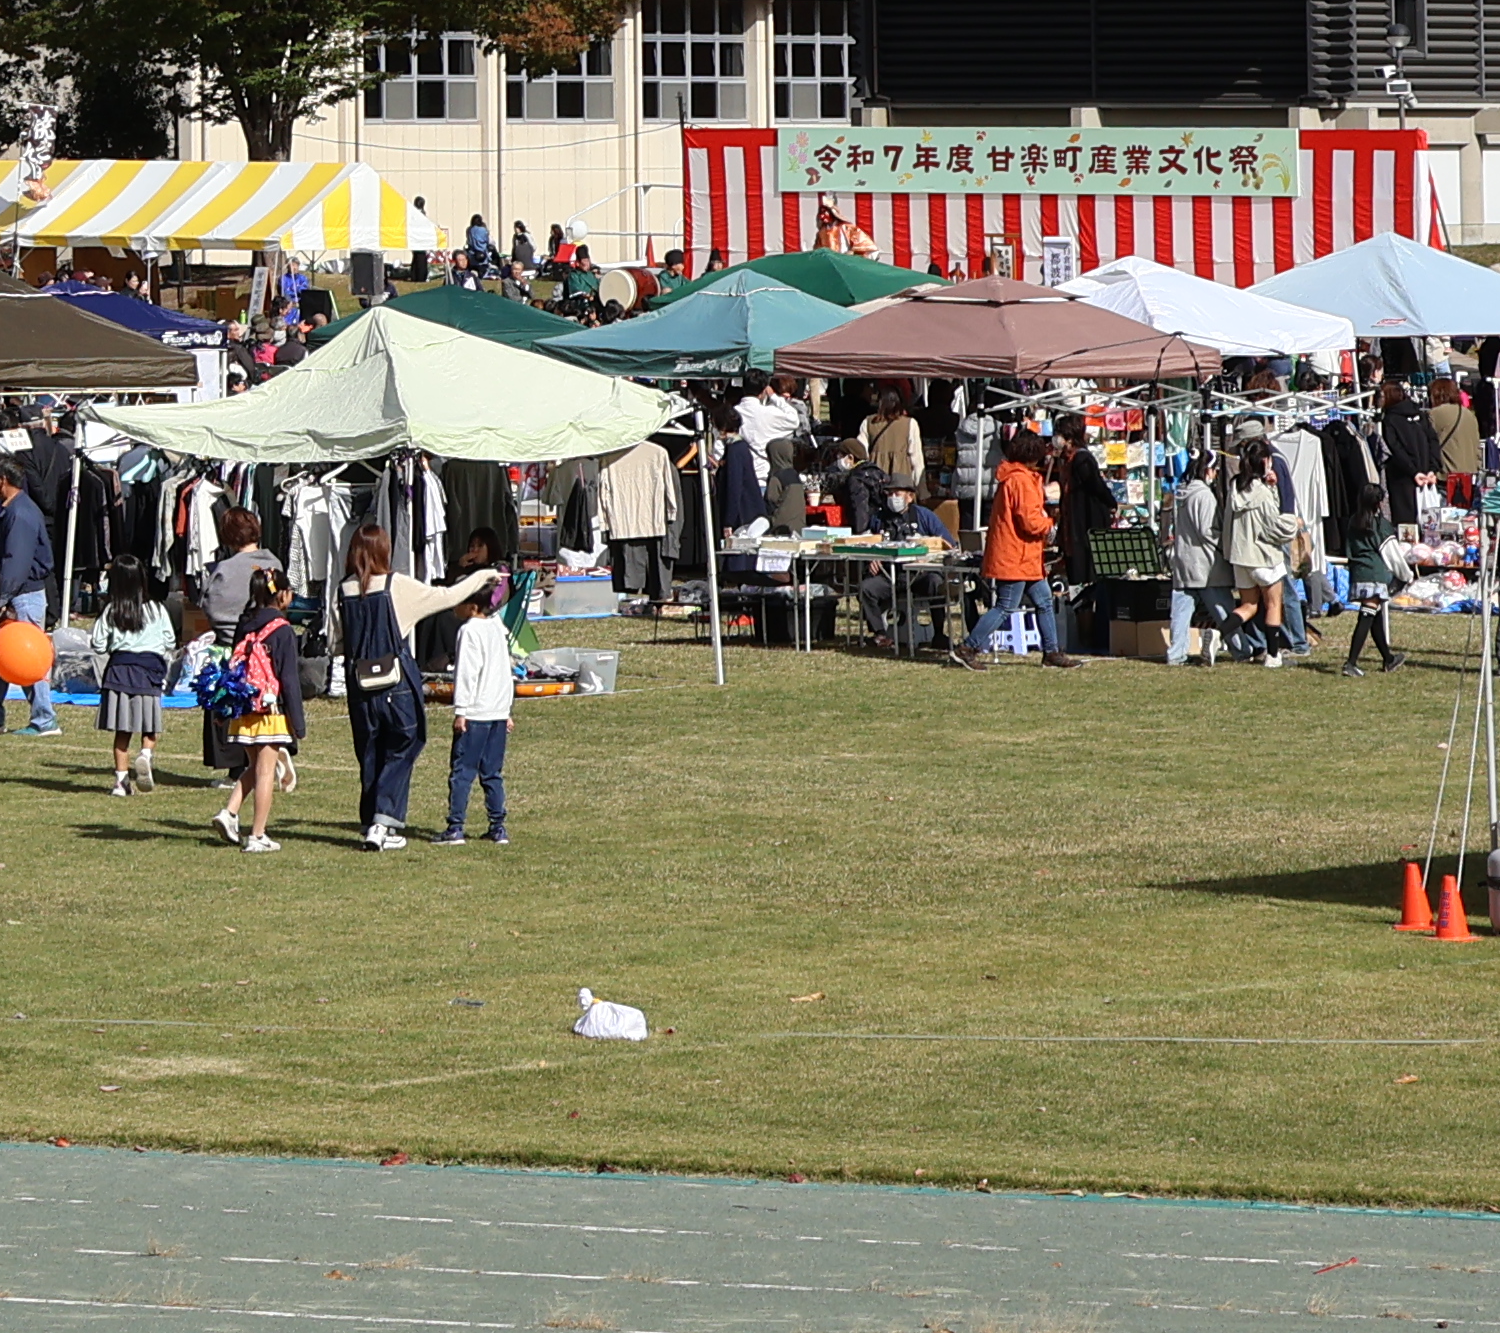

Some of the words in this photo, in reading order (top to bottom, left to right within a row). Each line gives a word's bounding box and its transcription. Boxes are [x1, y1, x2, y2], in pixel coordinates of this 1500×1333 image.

[813, 143, 975, 174] 令和7年度
[986, 143, 1260, 177] 甘楽町産業文化祭
